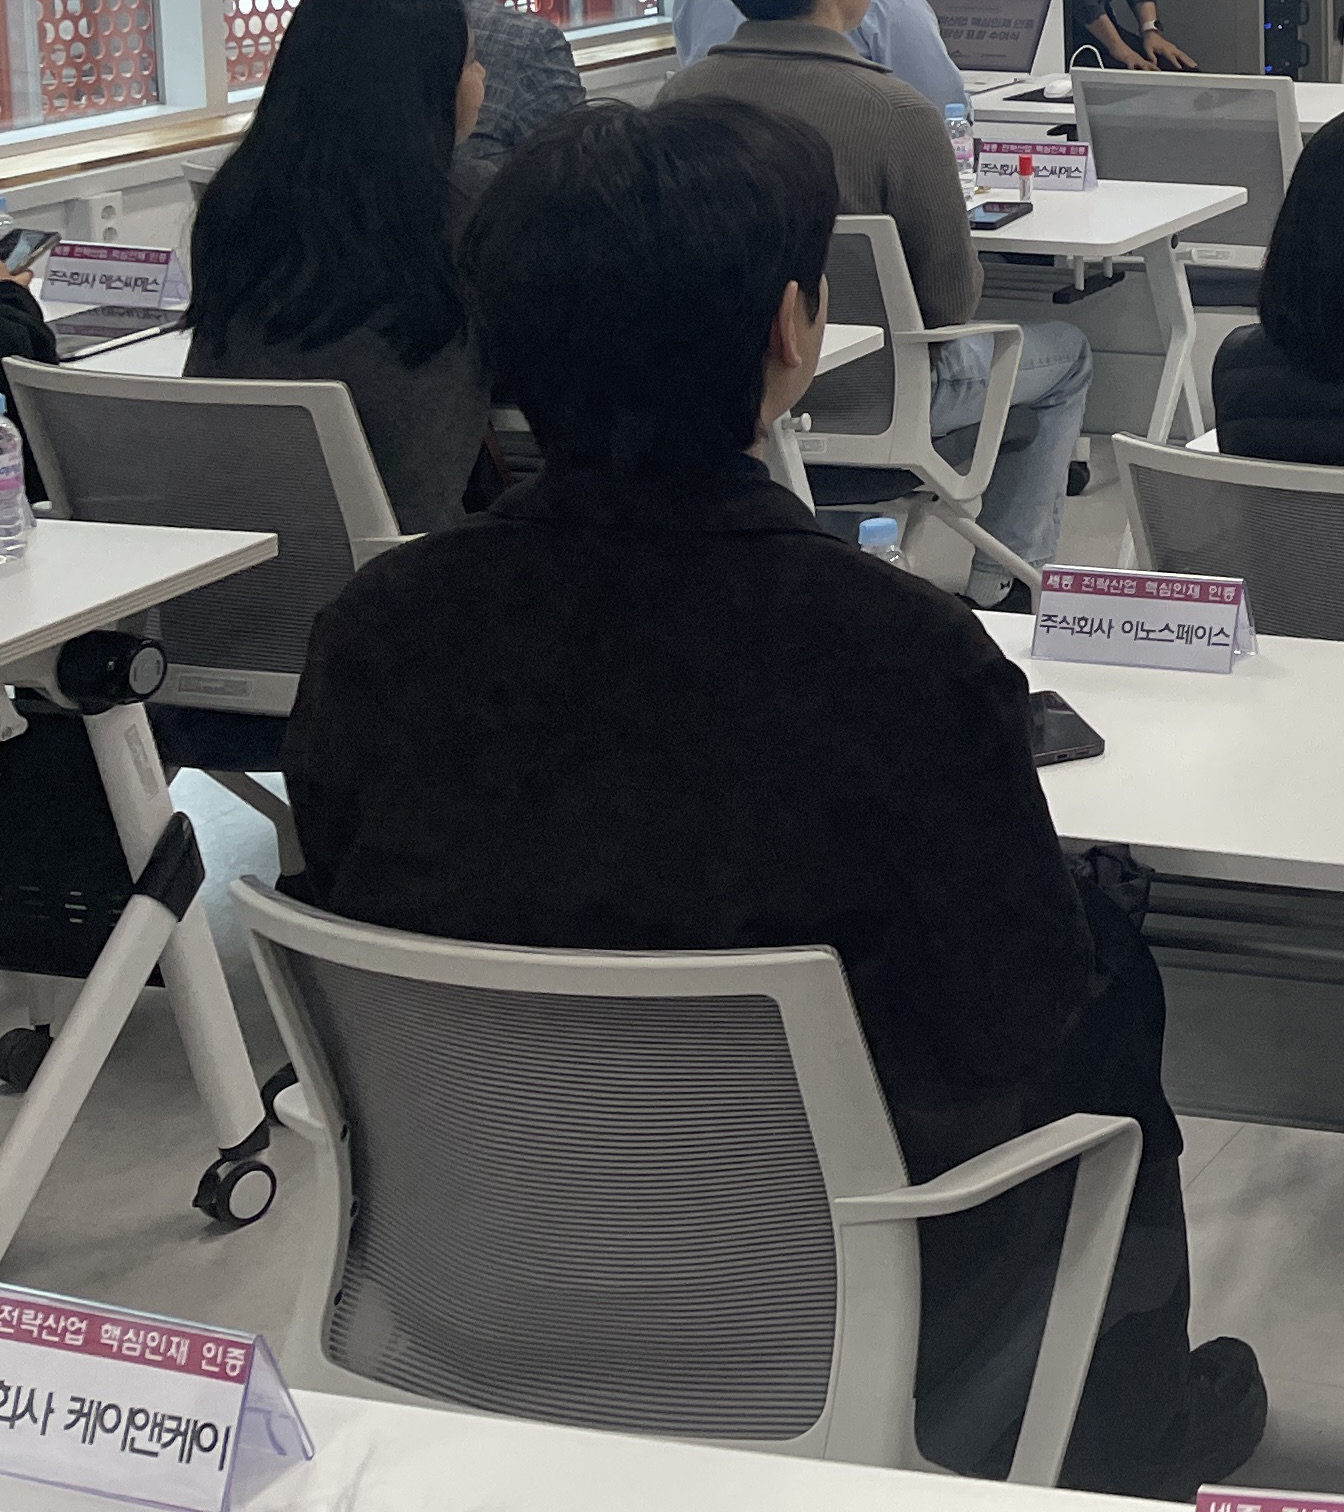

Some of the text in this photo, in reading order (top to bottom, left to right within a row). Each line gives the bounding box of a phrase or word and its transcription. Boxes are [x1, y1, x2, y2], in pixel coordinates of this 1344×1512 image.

[1047, 574, 1237, 602] 세종 전략산업 핵심인재 인증
[1039, 613, 1231, 647] 주식회사 이노스페이스
[99, 1322, 191, 1366] 핵심인재
[201, 1342, 247, 1377] 인증
[63, 1395, 232, 1472] 케이앤케이
